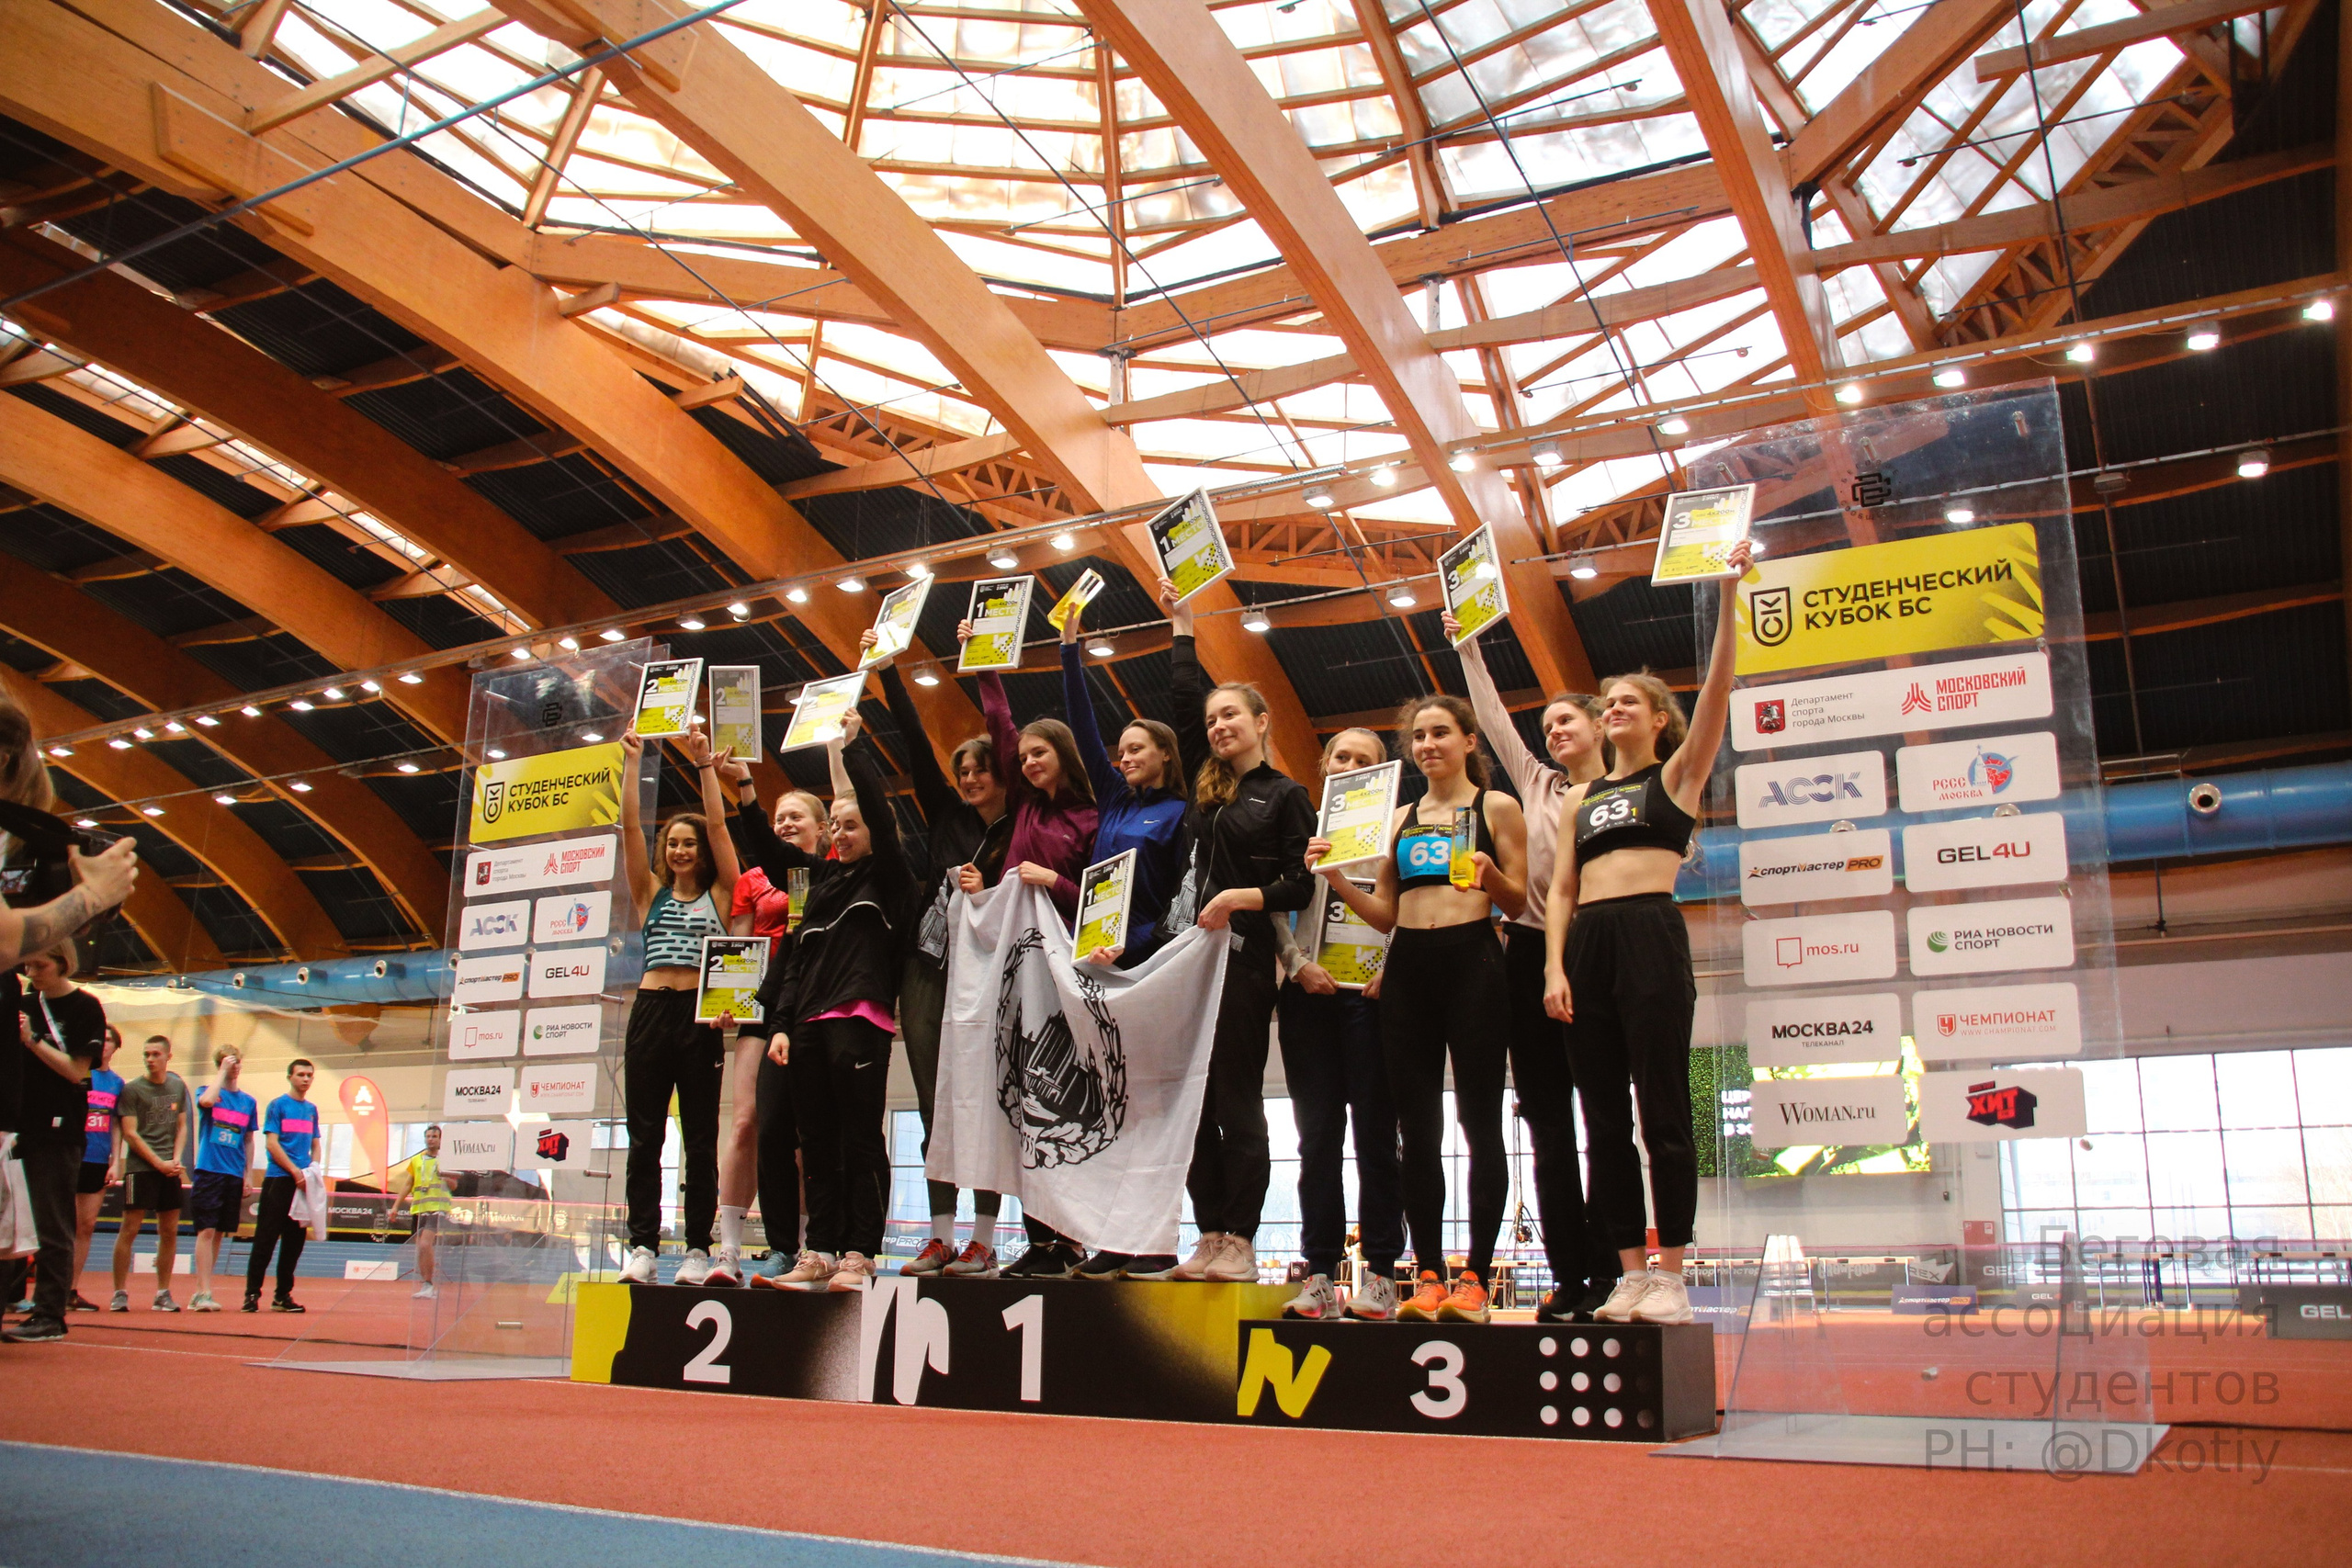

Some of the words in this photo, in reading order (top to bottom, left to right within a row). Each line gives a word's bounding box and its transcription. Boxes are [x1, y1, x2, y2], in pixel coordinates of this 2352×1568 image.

[1672, 512, 1690, 529] 3
[1159, 536, 1170, 552] 1
[1447, 570, 1460, 590] 3
[1803, 559, 2012, 607] СТУДЕНЧЕСКИЙ
[977, 602, 985, 617] 1
[985, 606, 1017, 616] МЕСТО
[1804, 602, 1892, 630] КУБОК
[1899, 596, 1932, 616] БС
[645, 679, 659, 694] 2
[1936, 666, 2027, 694] МОСКОВСКИЙ
[716, 687, 726, 705] 2
[1791, 692, 1854, 706] Департамент
[1938, 692, 1979, 712] СПОРТ
[1792, 706, 1824, 718] спорта
[1792, 716, 1825, 729] города
[1826, 712, 1865, 723] Москвы
[509, 768, 610, 797] СТУДЕНЧЕСКИЙ
[508, 793, 548, 813] КУБОК
[552, 792, 569, 806] БС
[1939, 788, 1984, 801] МОСКВА
[1329, 794, 1346, 813] 3
[1589, 798, 1629, 827] 63
[561, 844, 605, 862] МОСКОВСКИЙ
[1409, 840, 1449, 866] 63
[1937, 841, 2031, 864] GEL4U
[560, 861, 581, 874] СПОРТ
[1760, 860, 1845, 878] спортмастер
[1847, 856, 1882, 871] PRO
[1086, 887, 1093, 906] 1
[1328, 901, 1345, 922] 3
[1954, 929, 1983, 940] РИА
[1985, 924, 2053, 938] НОВОСТИ
[1806, 941, 1860, 956] mos.ru
[1954, 938, 2000, 951] СПОРТ
[545, 964, 590, 979] GEL4U
[709, 955, 724, 972] 2
[503, 972, 519, 982] PRO
[546, 1023, 560, 1032] РИА
[560, 1021, 593, 1032] НОВОСТИ
[1960, 1010, 2056, 1026] ЧЕМПИОНАТ
[479, 1031, 503, 1041] mos.ru
[546, 1030, 567, 1039] СПОРТ
[1771, 1020, 1873, 1040] МОСКВА24
[1802, 1039, 1845, 1048] ТЕЛЕКАНАЛ
[455, 1085, 502, 1097] МОСКВА24
[540, 1081, 585, 1091] ЧЕМПИОНАТ
[87, 1115, 103, 1127] 31
[683, 1300, 732, 1384] 2
[1001, 1294, 1044, 1402] 1
[1409, 1339, 1466, 1418] 3
